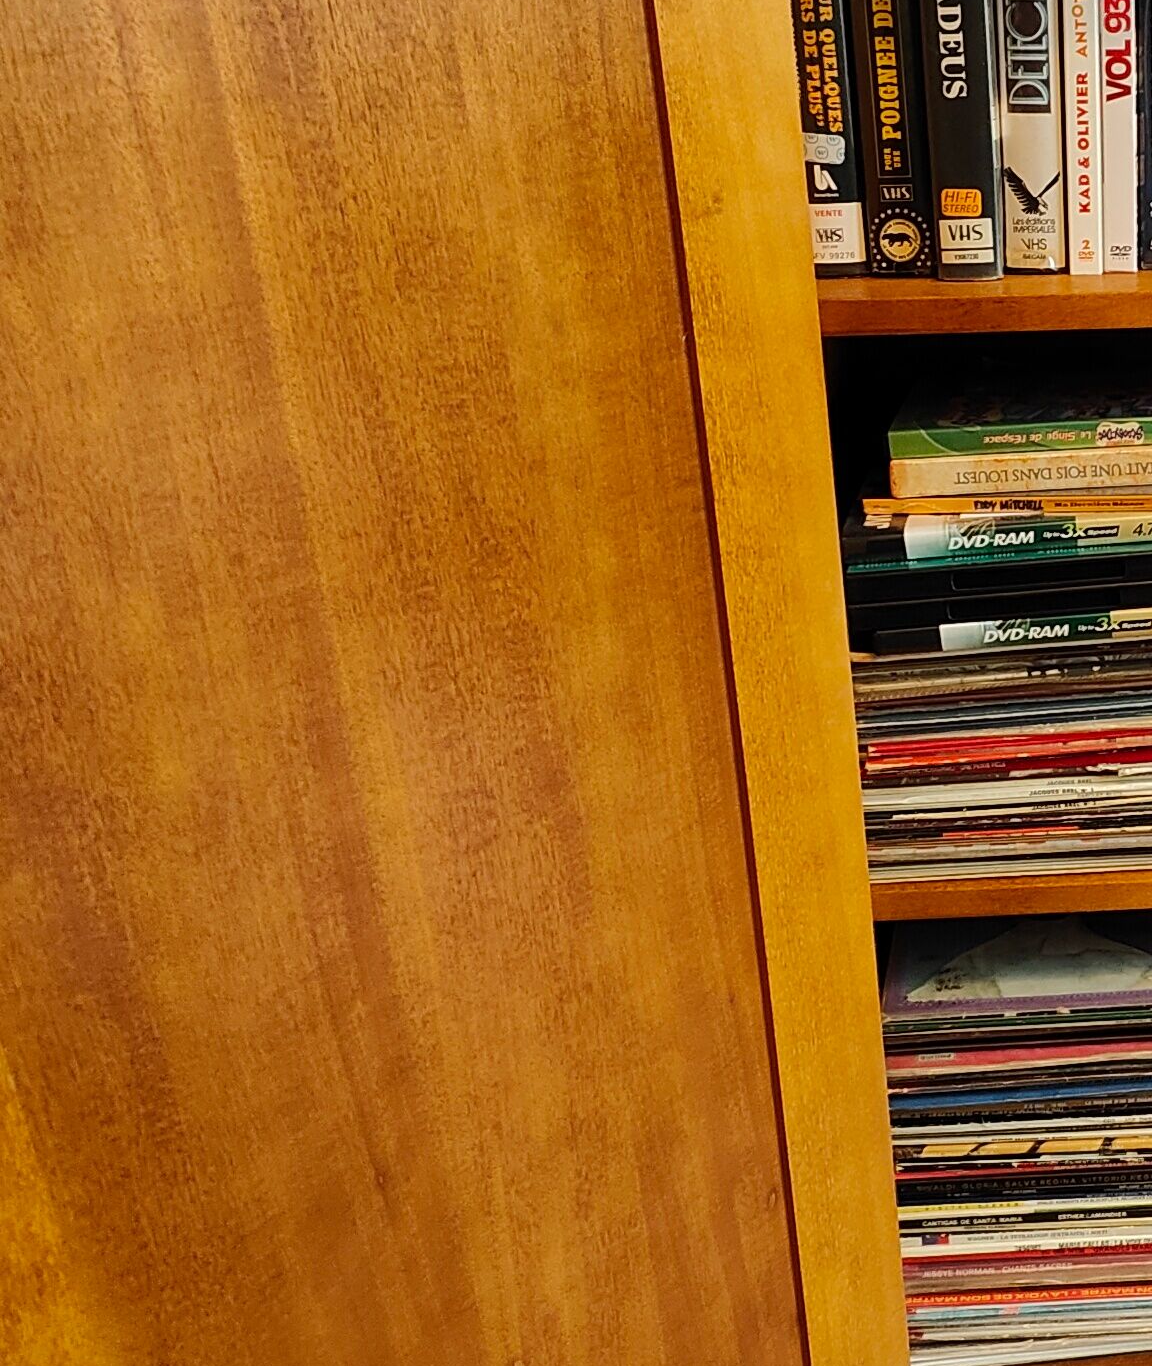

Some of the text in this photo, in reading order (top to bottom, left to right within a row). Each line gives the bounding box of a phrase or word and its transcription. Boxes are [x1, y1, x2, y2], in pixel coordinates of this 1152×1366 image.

[802, 29, 819, 58] DE
[1104, 39, 1132, 103] VOL
[819, 28, 844, 133] QUELQUES
[874, 36, 902, 141] POIGNEE
[1076, 72, 1090, 151] OLIVIER
[883, 147, 893, 172] POUR
[893, 150, 902, 169] UNE
[1078, 156, 1091, 169] &
[882, 187, 911, 200] VHS
[943, 191, 978, 204] HI-FI
[1078, 175, 1092, 213] KAD
[815, 209, 843, 217] VENTE
[943, 204, 979, 214] STEREO
[816, 228, 844, 243] VHS
[947, 223, 984, 242] VHS
[1012, 225, 1056, 234] IMPERIALES
[1021, 238, 1048, 251] VHS
[1081, 239, 1091, 250] 2
[1110, 244, 1133, 254] DVD
[1029, 433, 1043, 442] de
[1046, 430, 1076, 443] Singe
[1080, 430, 1092, 439] Le
[954, 469, 1009, 485] L'OUEST
[1013, 467, 1052, 481] DANS
[1056, 466, 1088, 479] FOIS
[1091, 464, 1122, 477] UNE
[973, 499, 1045, 511] EDDY MITCHELL
[1087, 527, 1119, 536] Speed
[948, 530, 1035, 551] DVD-RAM
[1121, 621, 1152, 629] Speed
[983, 624, 1070, 644] DVD-RAM
[1039, 1177, 1076, 1186] REGINA
[921, 1219, 958, 1227] CANTIGAS
[973, 1217, 997, 1225] SANTA
[955, 1267, 995, 1276] NORMAN
[960, 1294, 991, 1302] SON
[993, 1292, 1013, 1301] DE
[1015, 1290, 1050, 1299] VOIX
